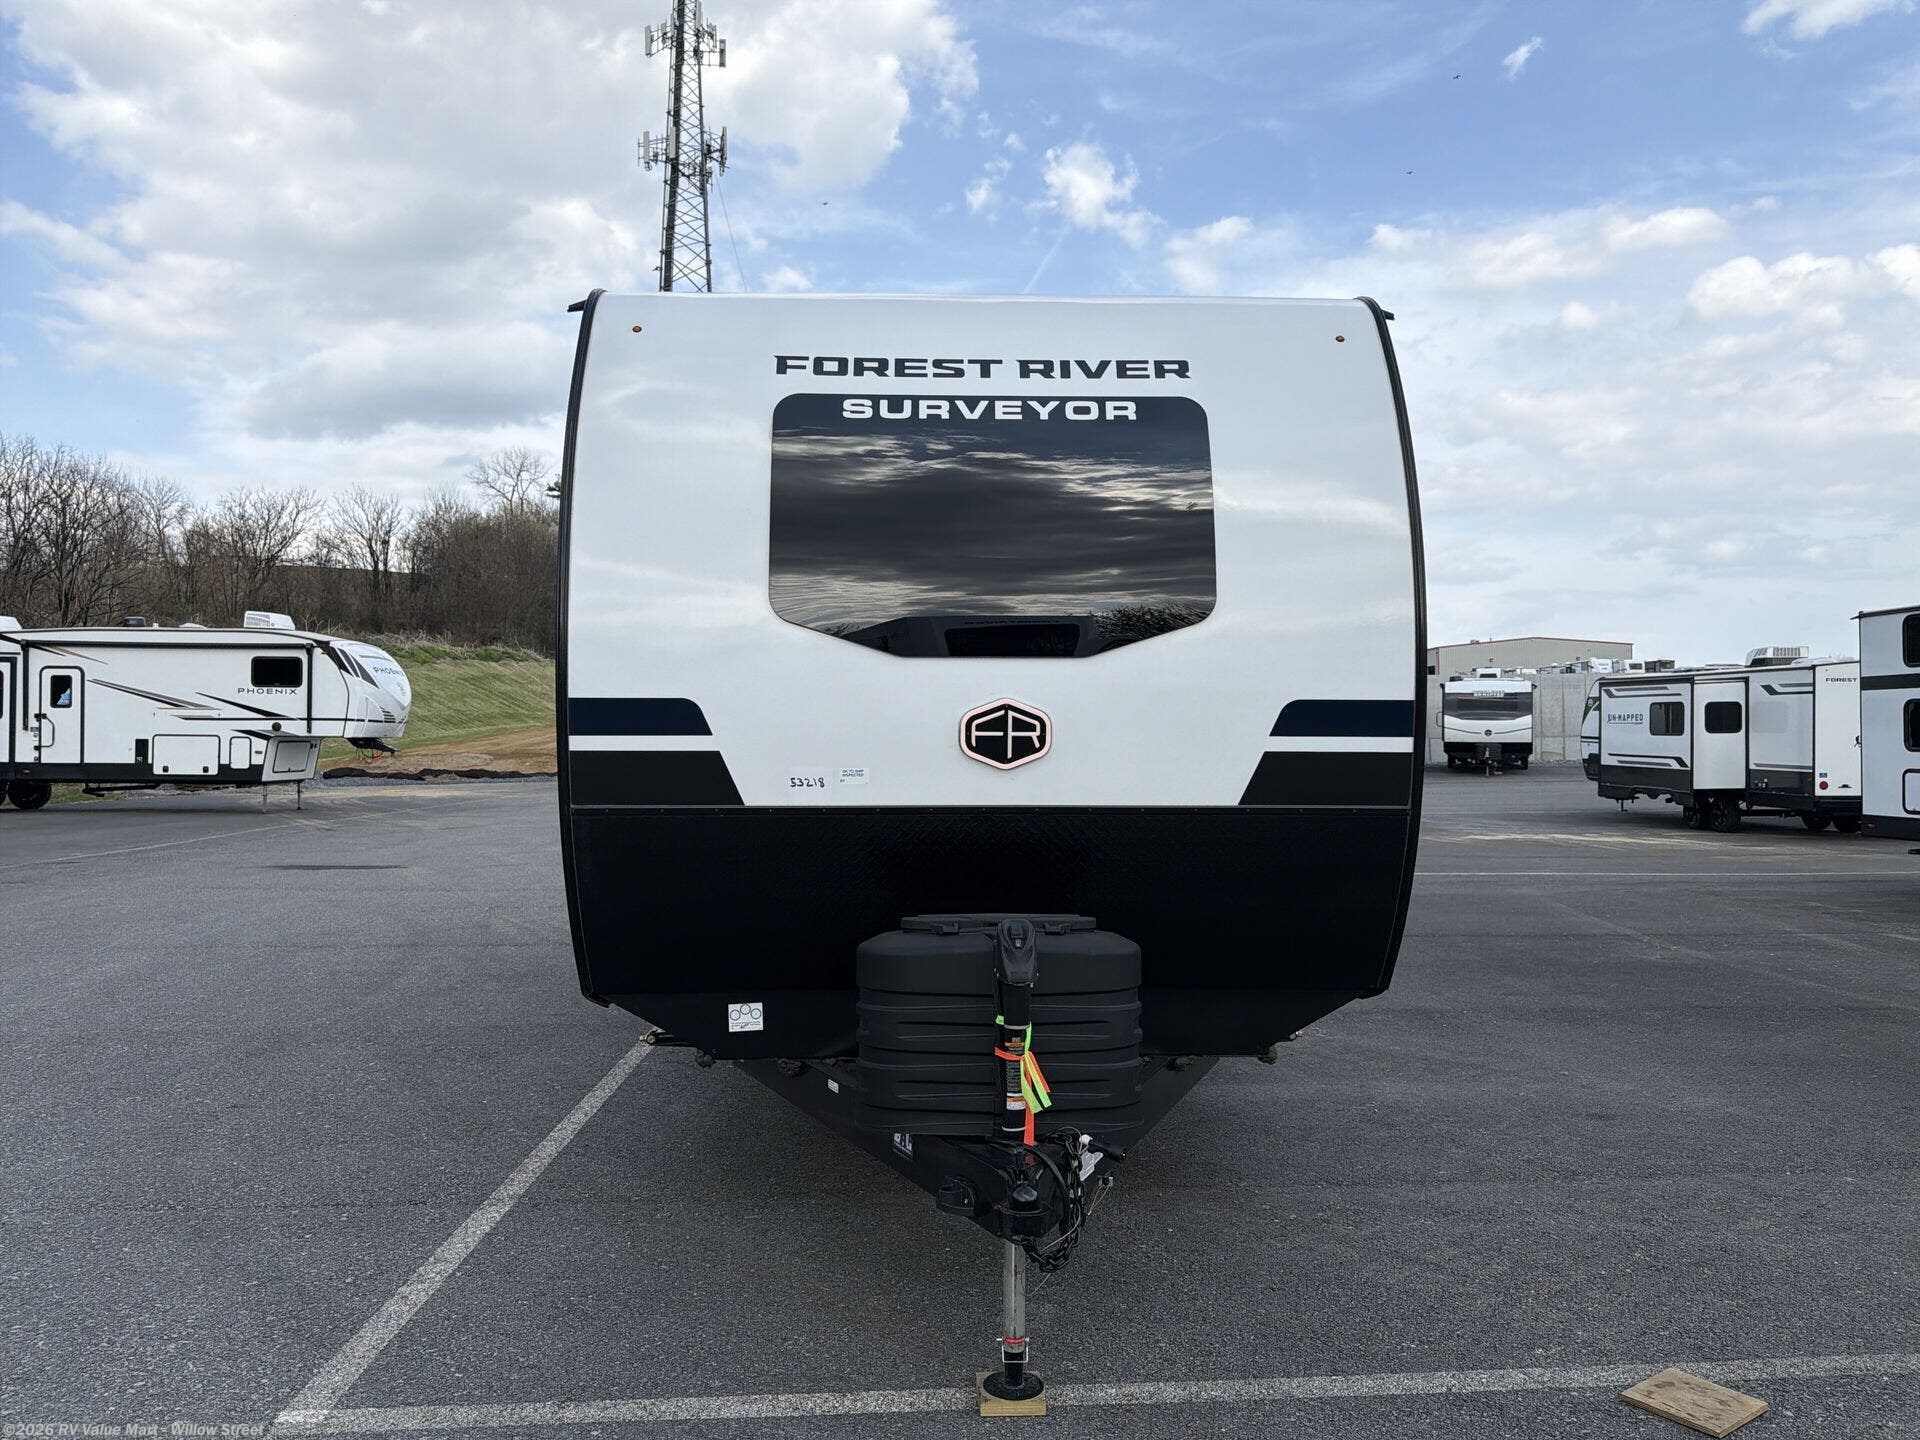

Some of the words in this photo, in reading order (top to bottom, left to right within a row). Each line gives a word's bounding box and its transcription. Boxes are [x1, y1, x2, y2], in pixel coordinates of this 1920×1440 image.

[773, 355, 1003, 379] FOREST
[1016, 359, 1192, 380] RIVER
[842, 398, 1137, 421] SURVEYOR
[237, 687, 298, 695] PHOENIX
[790, 777, 825, 788] 53218
